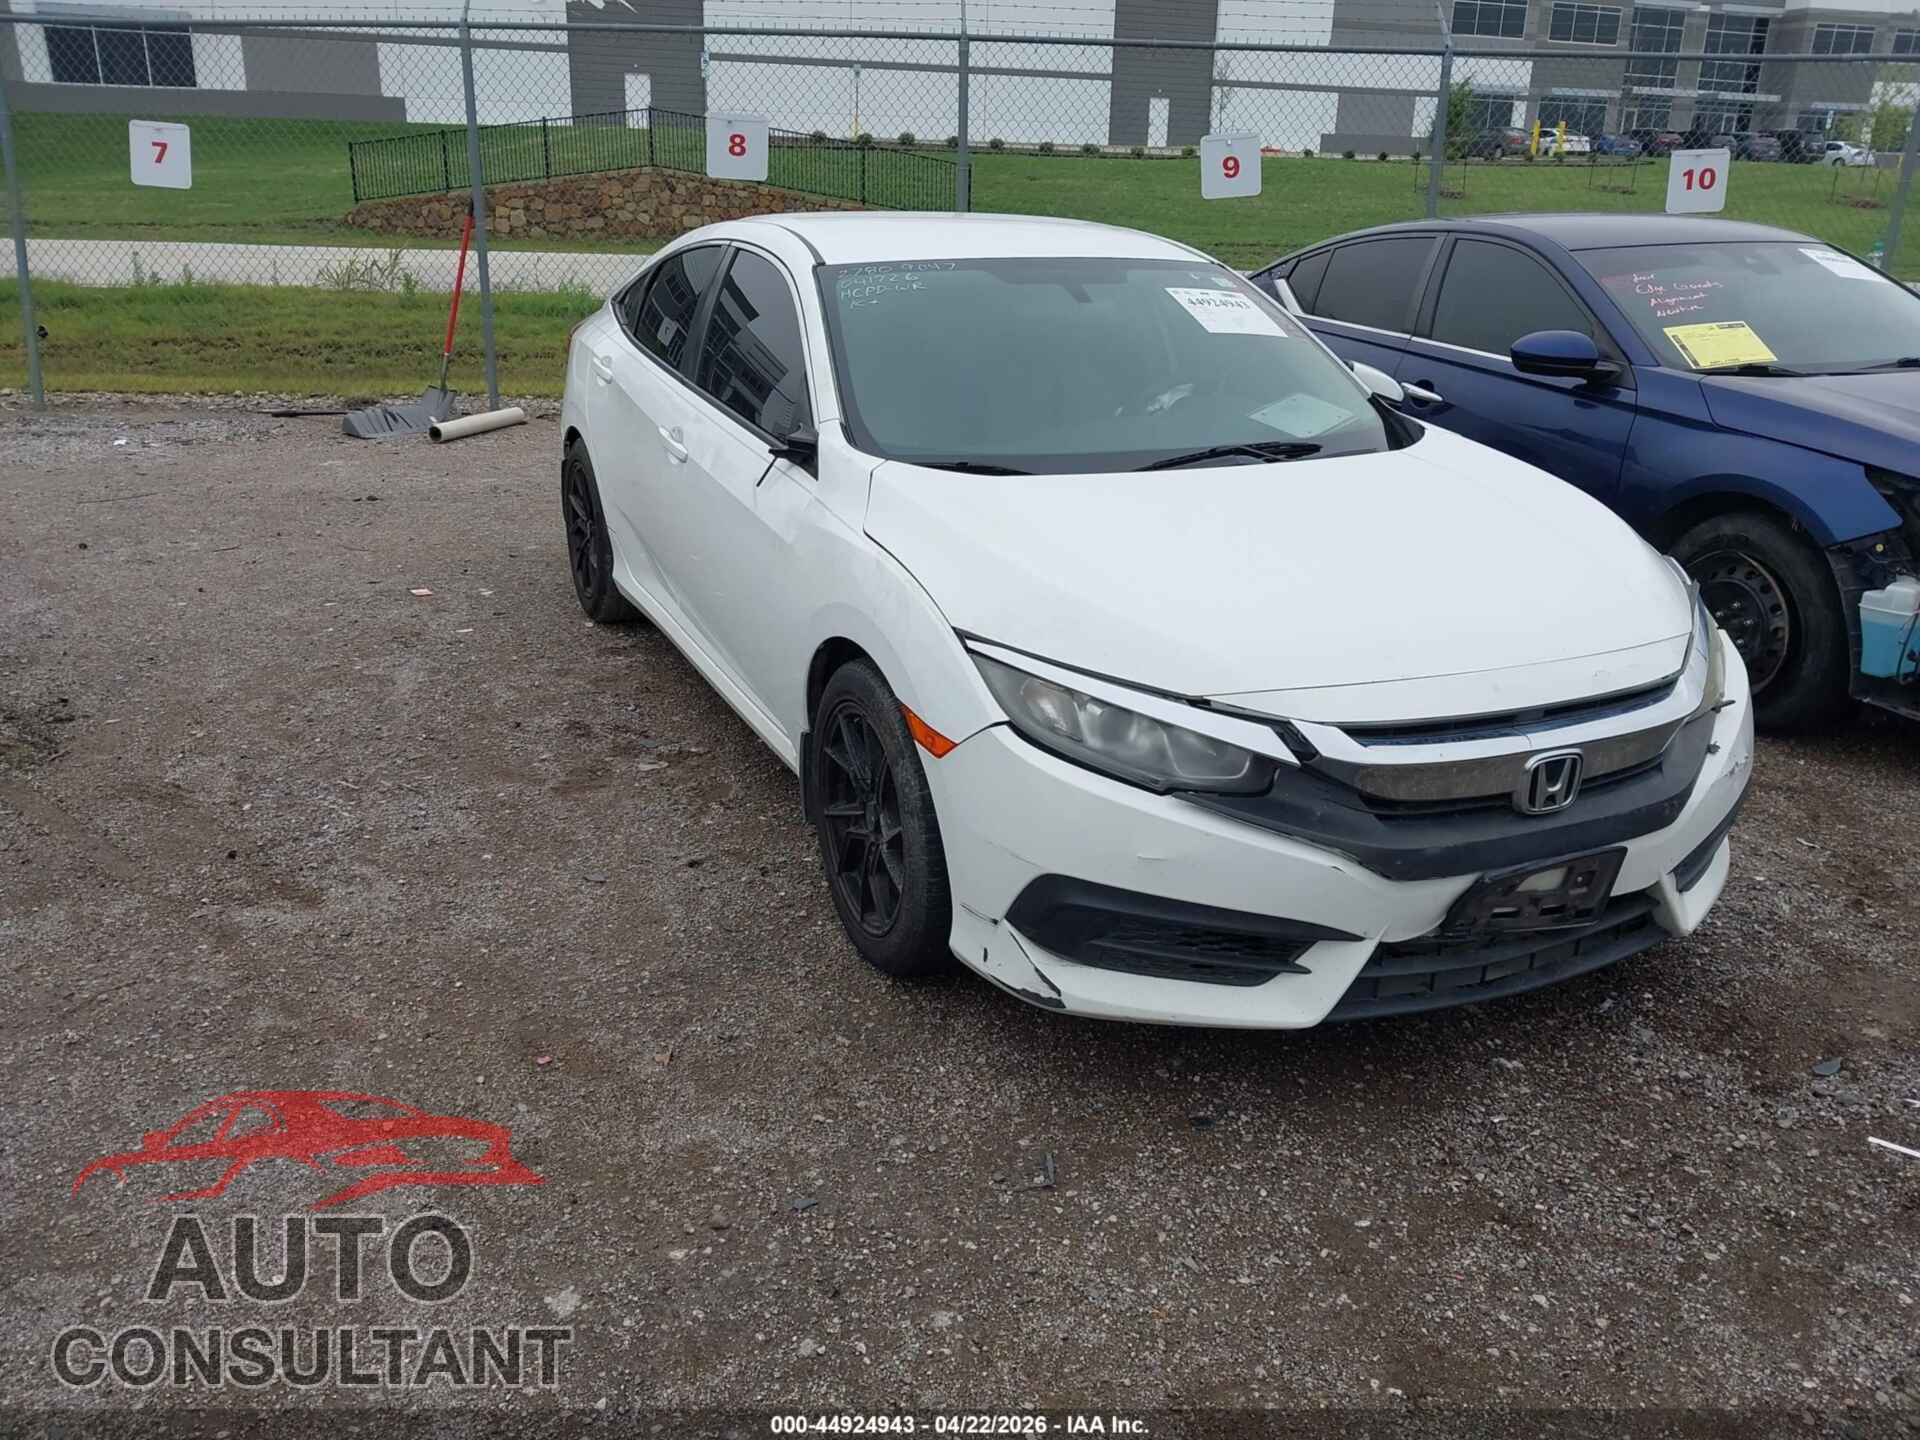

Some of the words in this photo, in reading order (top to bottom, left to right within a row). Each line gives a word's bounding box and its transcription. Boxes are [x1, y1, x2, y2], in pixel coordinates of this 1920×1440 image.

[151, 141, 168, 164] 7
[728, 133, 747, 157] 8
[1222, 155, 1240, 179] 9
[1682, 167, 1716, 191] 10
